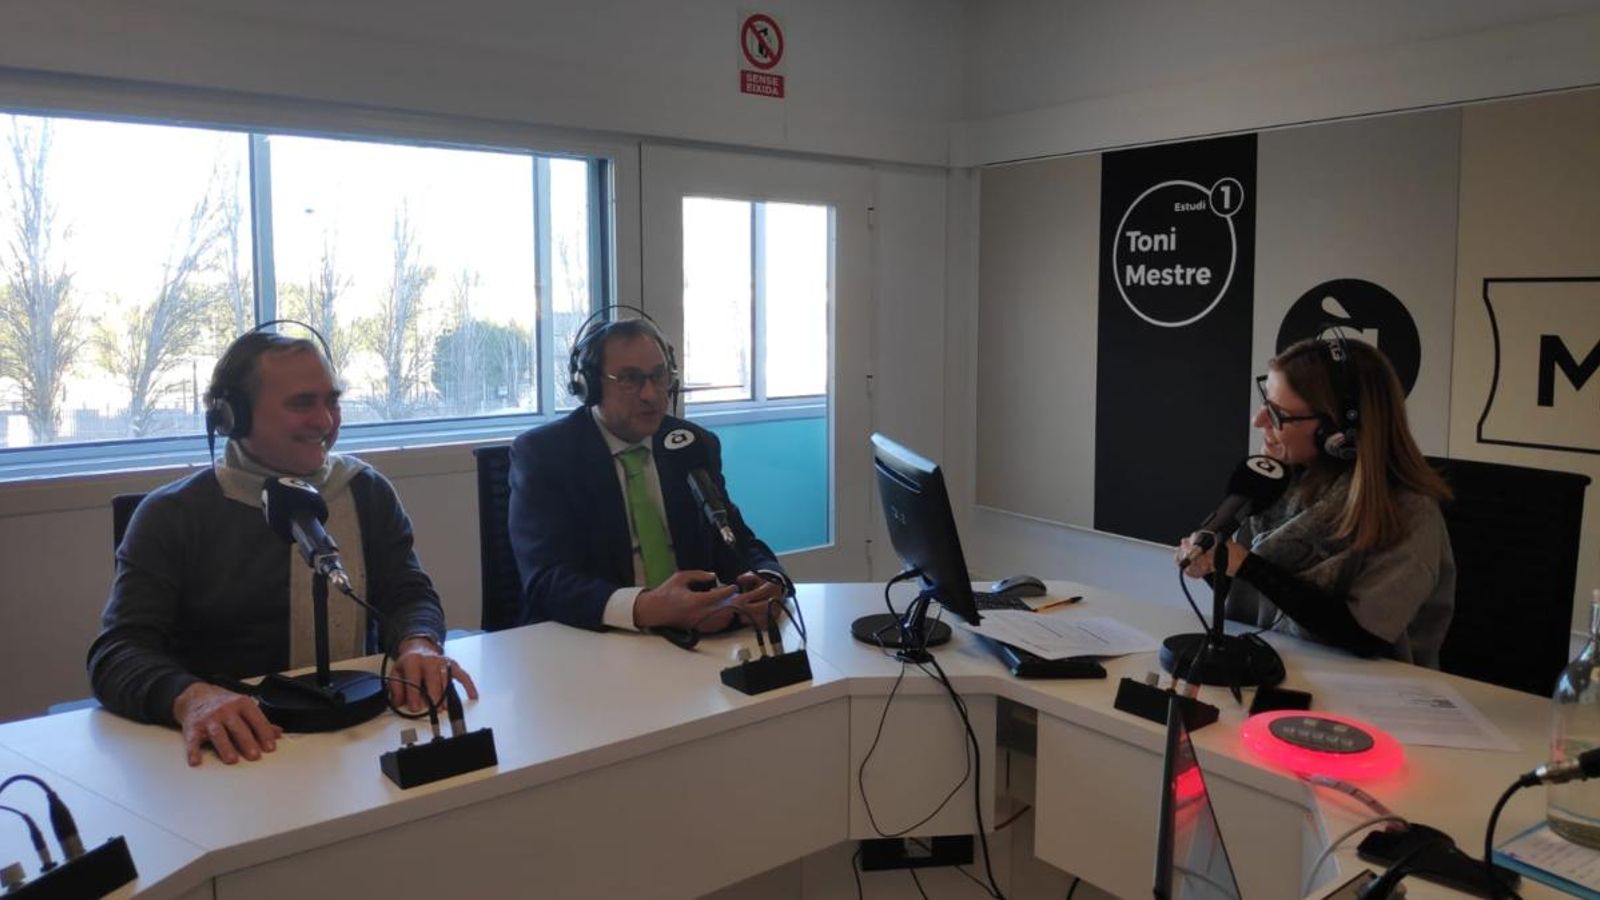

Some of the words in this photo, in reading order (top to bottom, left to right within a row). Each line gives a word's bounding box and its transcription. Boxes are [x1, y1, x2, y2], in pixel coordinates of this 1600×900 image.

[746, 73, 780, 87] SENSE
[746, 82, 779, 96] EIXIDA
[1174, 201, 1206, 212] Estudi
[1219, 185, 1231, 209] 1
[1125, 226, 1176, 252] Toni
[1125, 264, 1211, 286] Mestre
